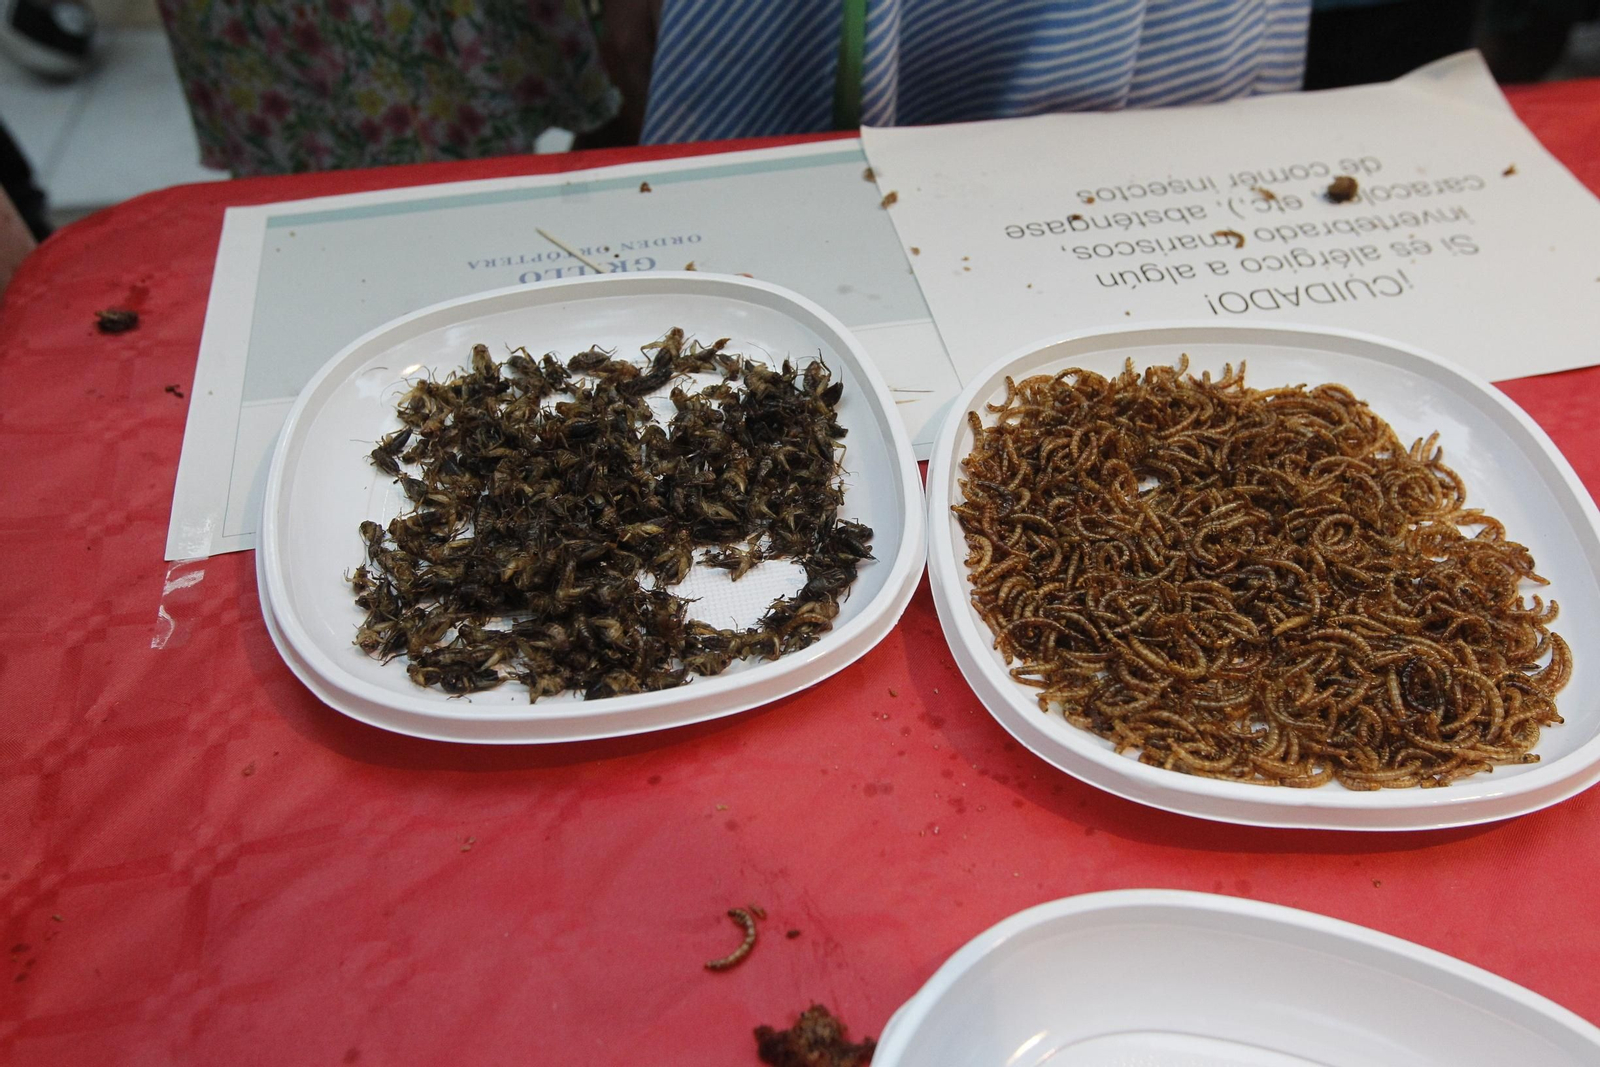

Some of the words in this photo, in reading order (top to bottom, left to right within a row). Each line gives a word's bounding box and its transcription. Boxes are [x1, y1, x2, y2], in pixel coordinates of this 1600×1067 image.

[1230, 161, 1331, 188] comer
[1337, 155, 1382, 178] de
[1076, 176, 1221, 204] insectos
[1004, 204, 1208, 239] absténgase
[1254, 205, 1475, 244] invertebrado
[620, 234, 703, 252] ORDEN
[1390, 238, 1433, 258] es
[1440, 234, 1481, 257] Si
[518, 256, 657, 284] GRLLO
[1208, 260, 1230, 276] a
[1240, 244, 1382, 274] alérgico
[1096, 263, 1197, 290] algún
[1203, 268, 1414, 315] ¡CUIDADO!
